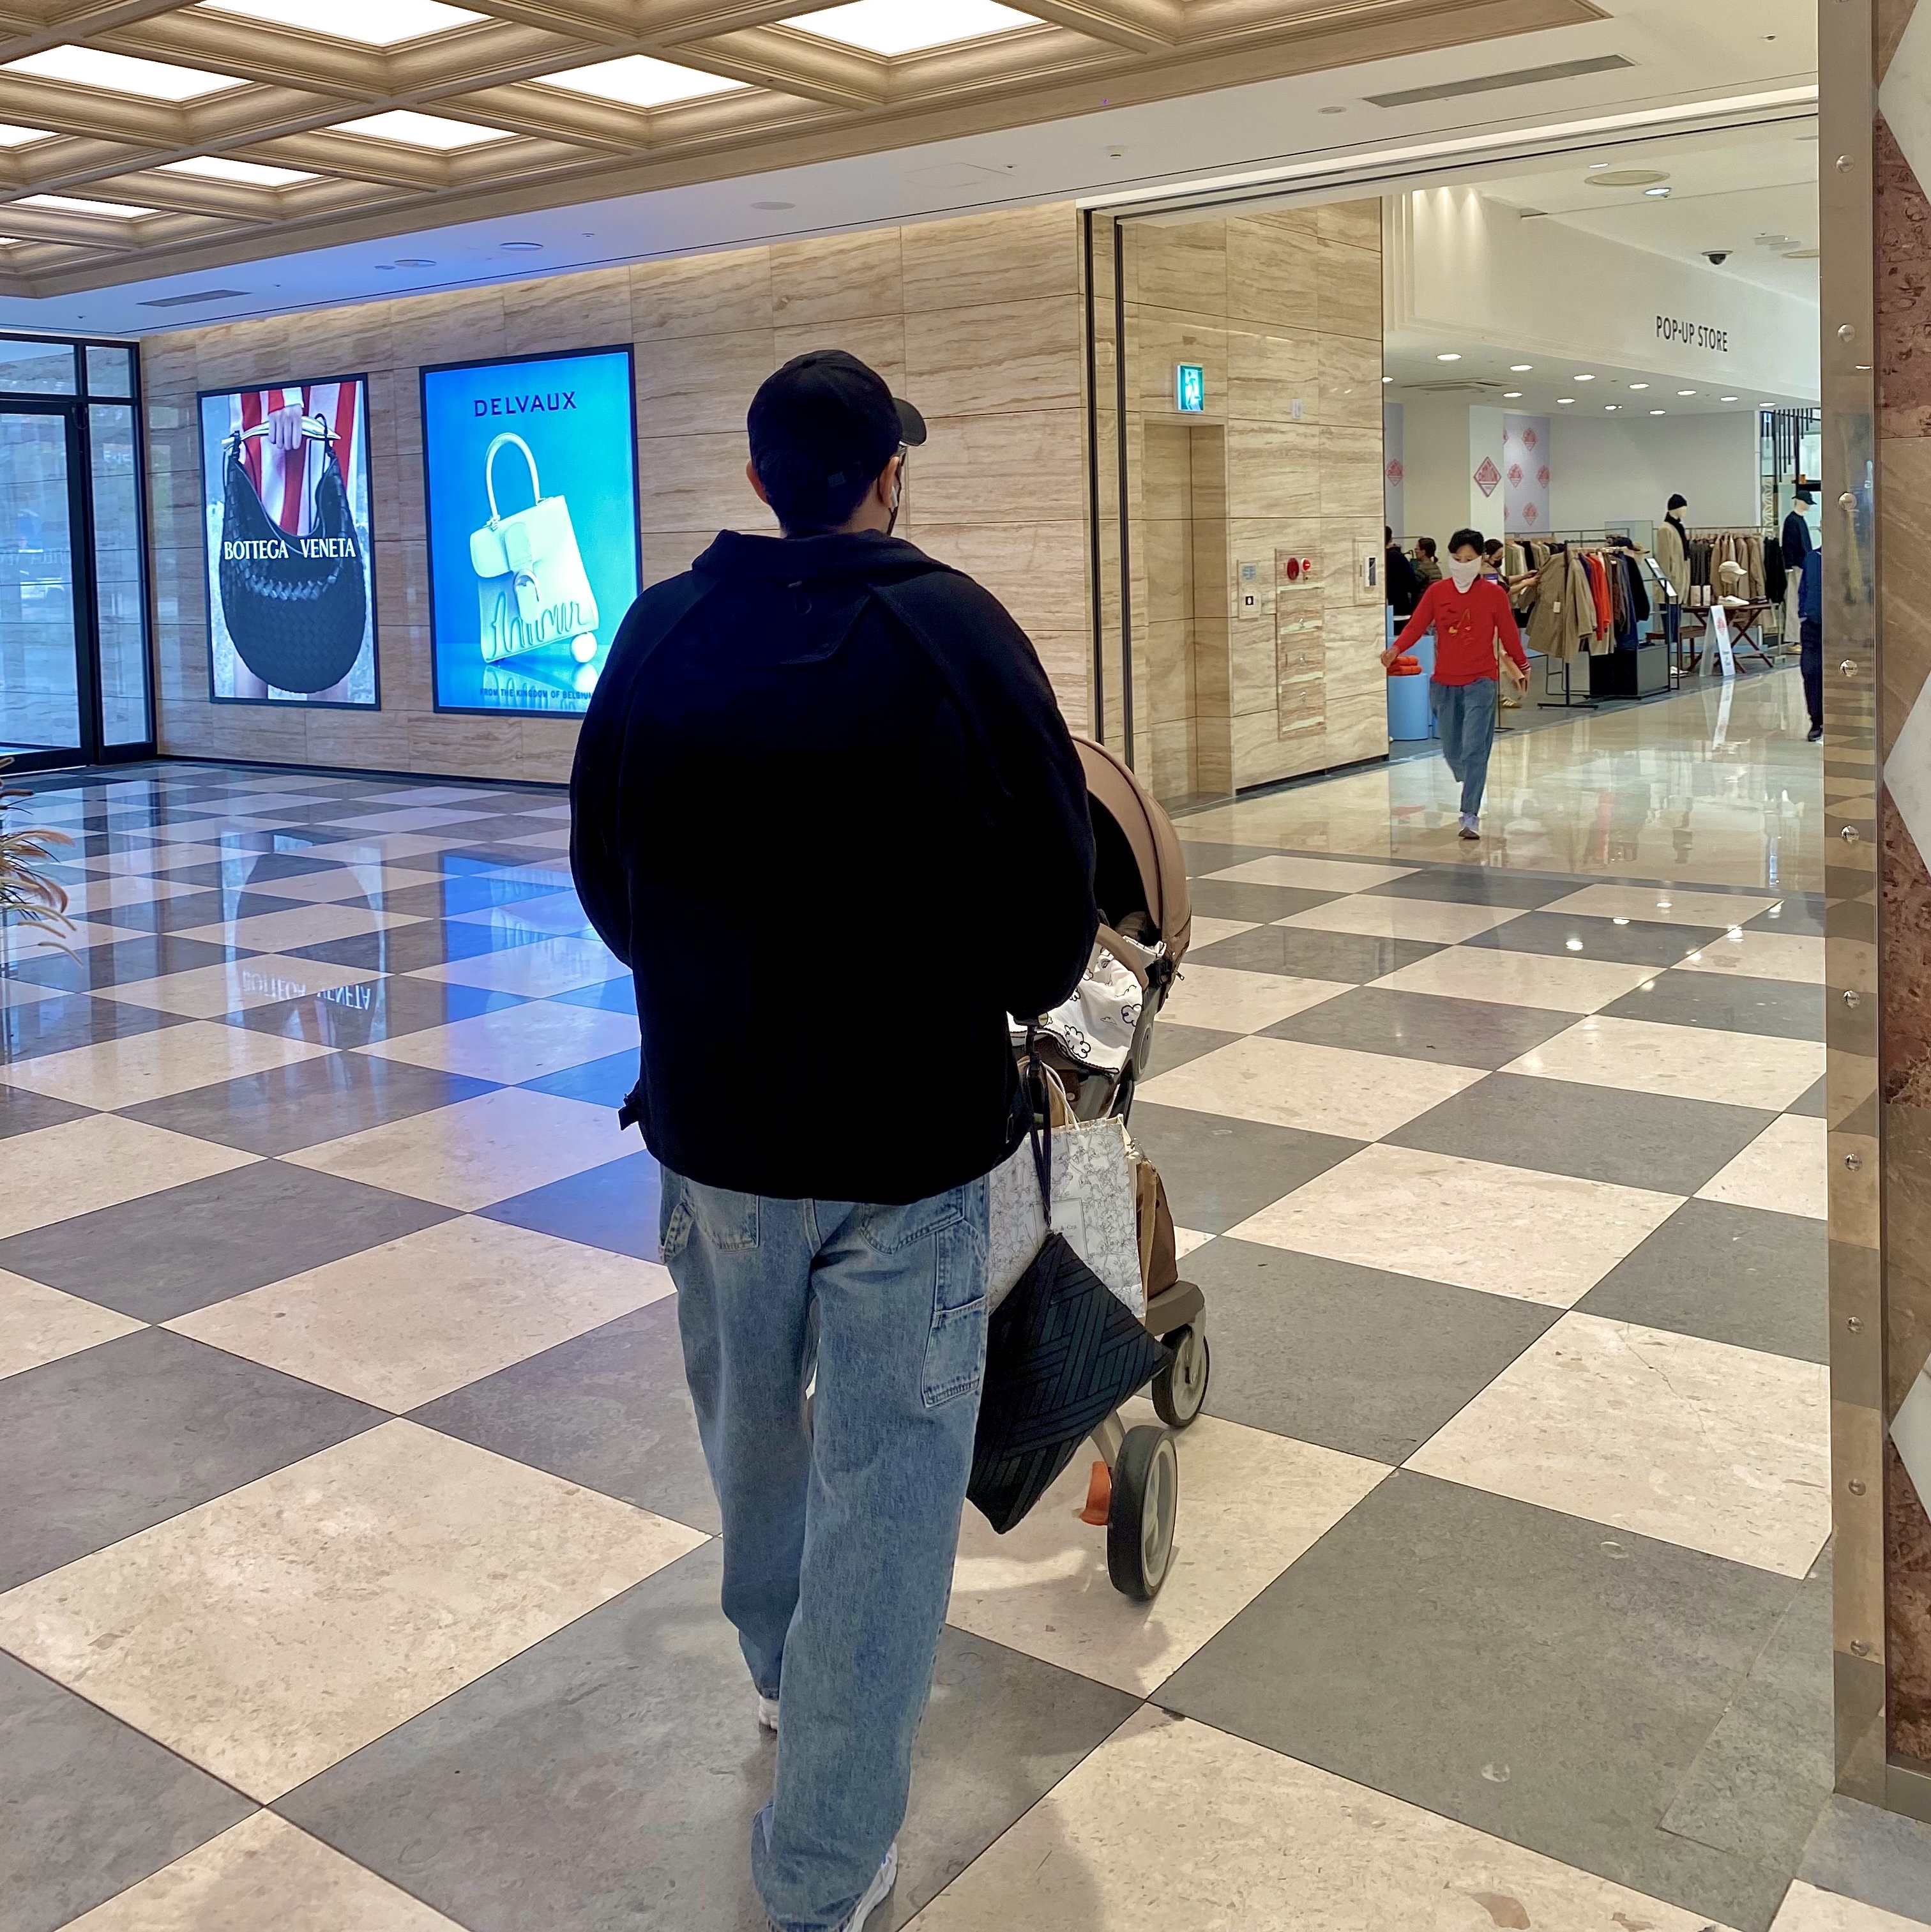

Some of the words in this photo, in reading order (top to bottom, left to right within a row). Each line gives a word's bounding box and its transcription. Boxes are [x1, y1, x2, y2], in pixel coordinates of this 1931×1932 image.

[1656, 316, 1695, 345] POP-UP
[1698, 325, 1728, 352] STORE
[474, 391, 577, 417] DELVAUX
[224, 540, 289, 560] BOTTEGA
[300, 538, 356, 558] VENETA
[480, 688, 498, 696] FROM
[501, 688, 513, 697] THE
[516, 689, 548, 698] KINGDOM
